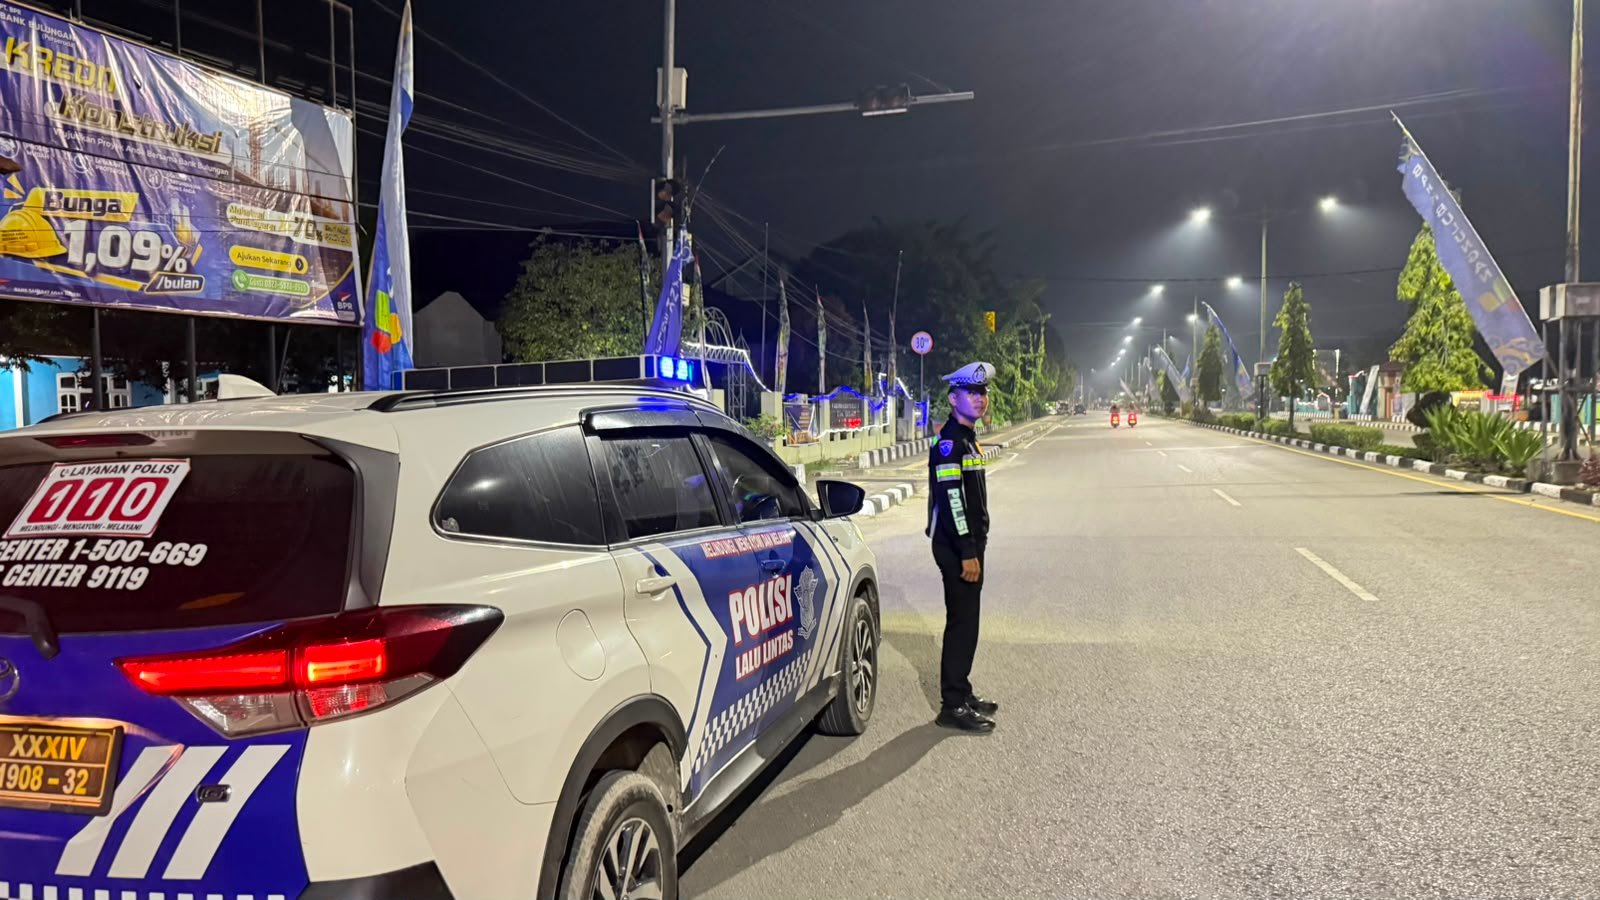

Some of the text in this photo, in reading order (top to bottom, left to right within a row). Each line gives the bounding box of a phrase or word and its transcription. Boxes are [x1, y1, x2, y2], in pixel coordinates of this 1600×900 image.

[0, 12, 26, 26] BANK
[58, 92, 223, 154] Konstruksi
[53, 127, 96, 145] ujukan
[97, 137, 125, 151] Proyk
[178, 157, 197, 168] Bank
[198, 162, 230, 176] Bulungan
[43, 191, 122, 217] Bunga
[63, 219, 188, 274] 1,09%
[237, 252, 292, 267] Ajukan Sekarang
[156, 277, 200, 290] /bulan
[337, 301, 353, 311] BPR
[70, 464, 180, 477] LAYANAN POLISI
[43, 481, 157, 518] 110
[947, 487, 970, 537] POLISI
[106, 523, 143, 531] MELAYANI
[69, 538, 208, 567] 1-500-669
[2, 563, 149, 591] CENTER 9119
[729, 574, 794, 646] POLISI
[735, 630, 794, 682] LALU LINTAS
[9, 733, 88, 761] XXXIV
[0, 763, 44, 792] 1908
[62, 767, 89, 795] 32
